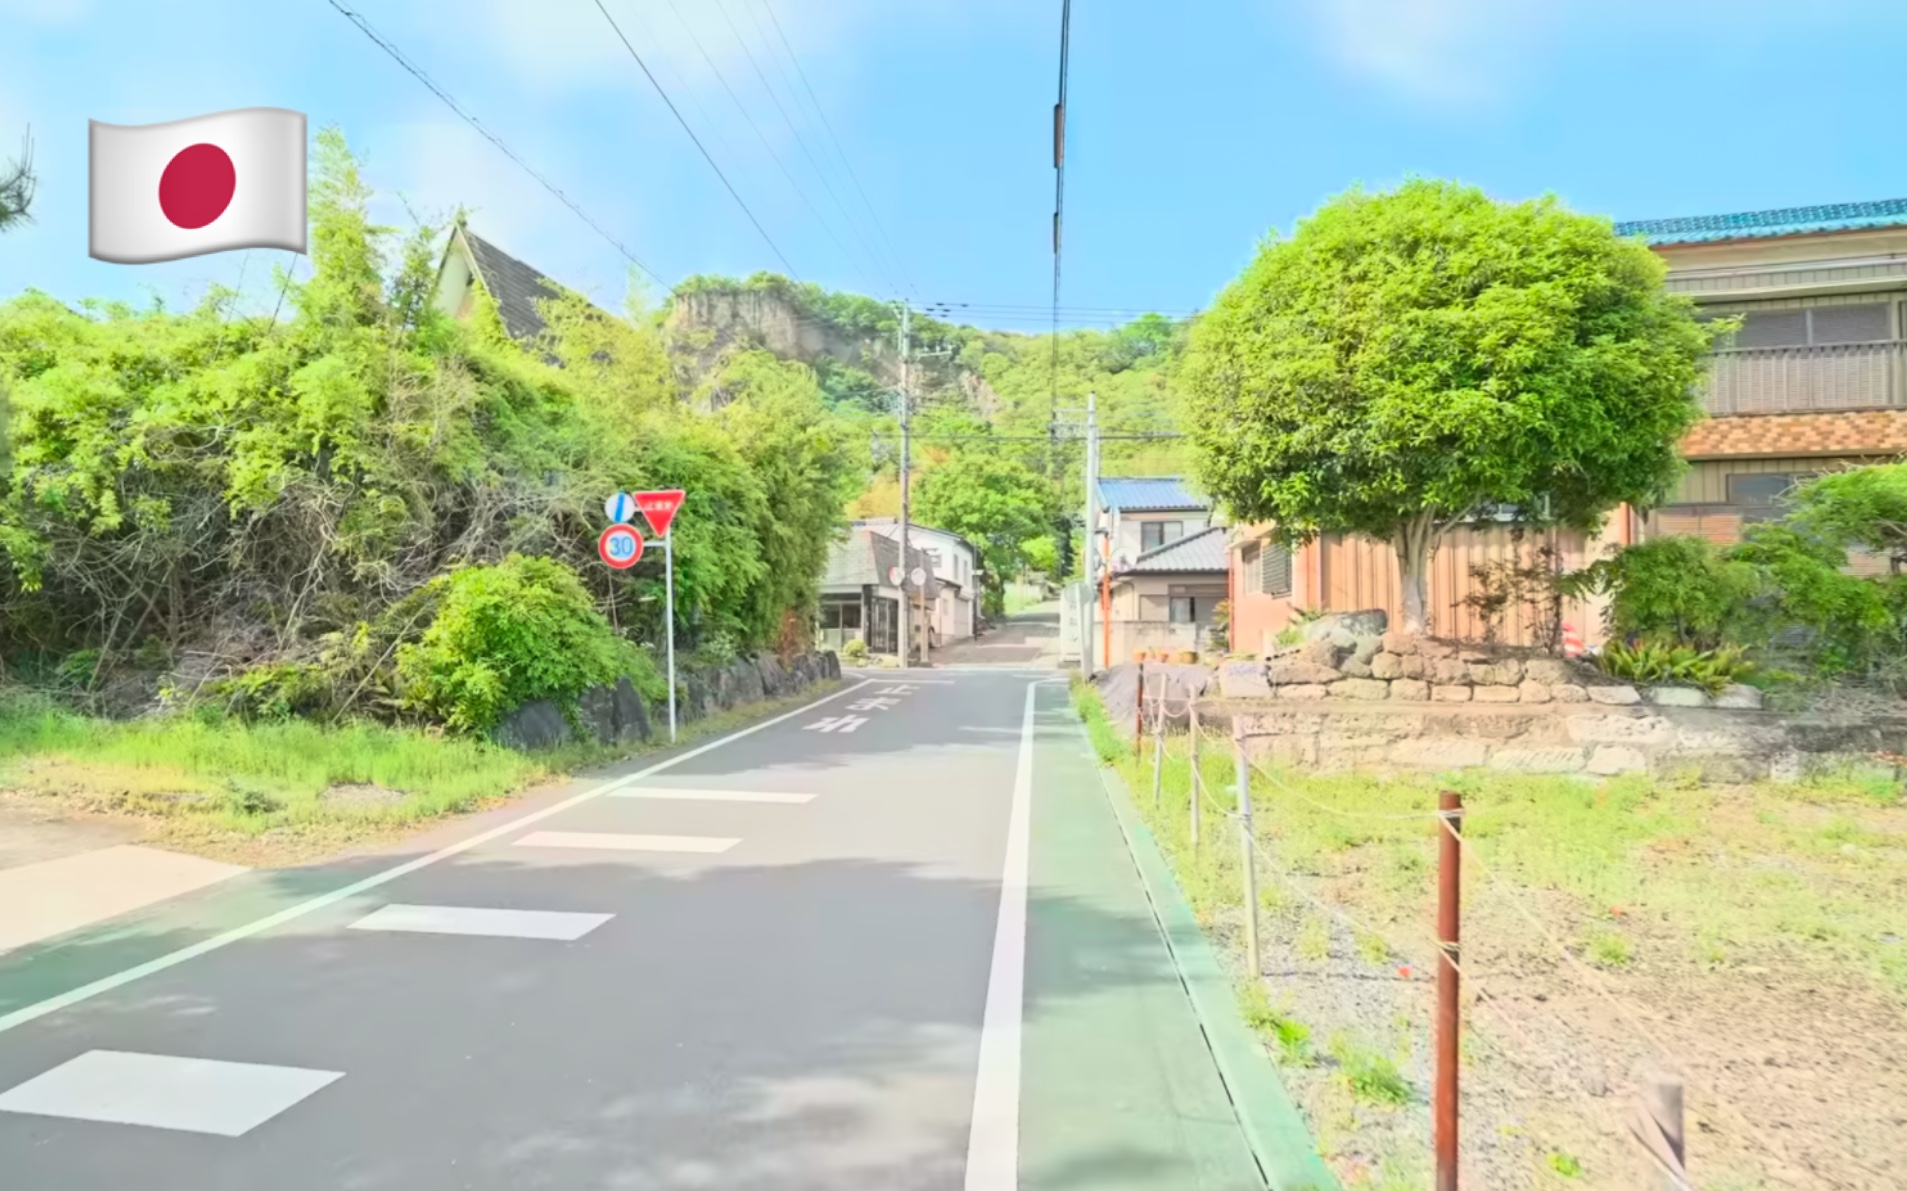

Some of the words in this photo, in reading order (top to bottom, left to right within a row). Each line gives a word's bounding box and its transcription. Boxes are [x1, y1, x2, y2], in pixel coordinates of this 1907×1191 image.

[609, 536, 633, 556] 30
[801, 684, 920, 733] 止まれ
